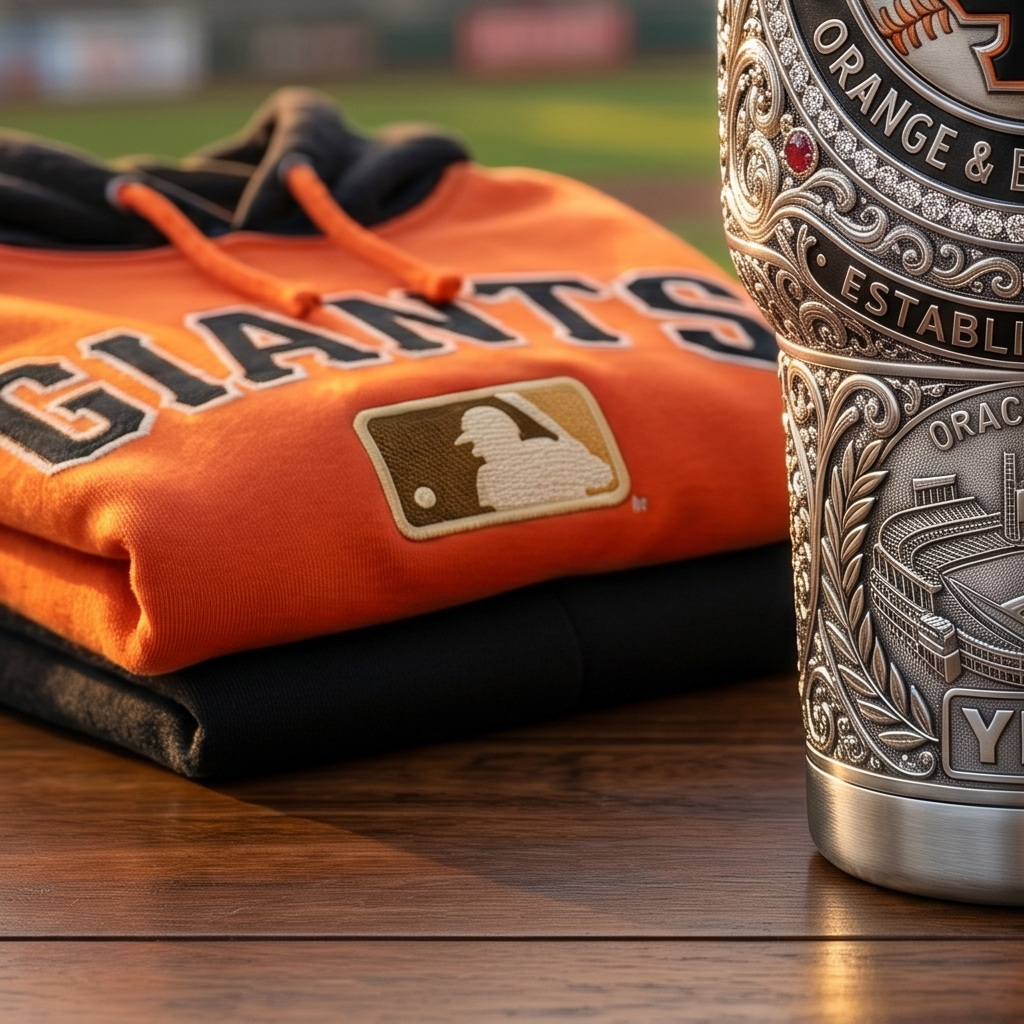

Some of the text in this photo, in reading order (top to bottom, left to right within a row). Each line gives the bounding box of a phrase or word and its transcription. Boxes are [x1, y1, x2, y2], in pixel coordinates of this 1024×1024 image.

[813, 17, 961, 169] ORANGE
[965, 141, 994, 182] &
[0, 271, 778, 475] GIANTS
